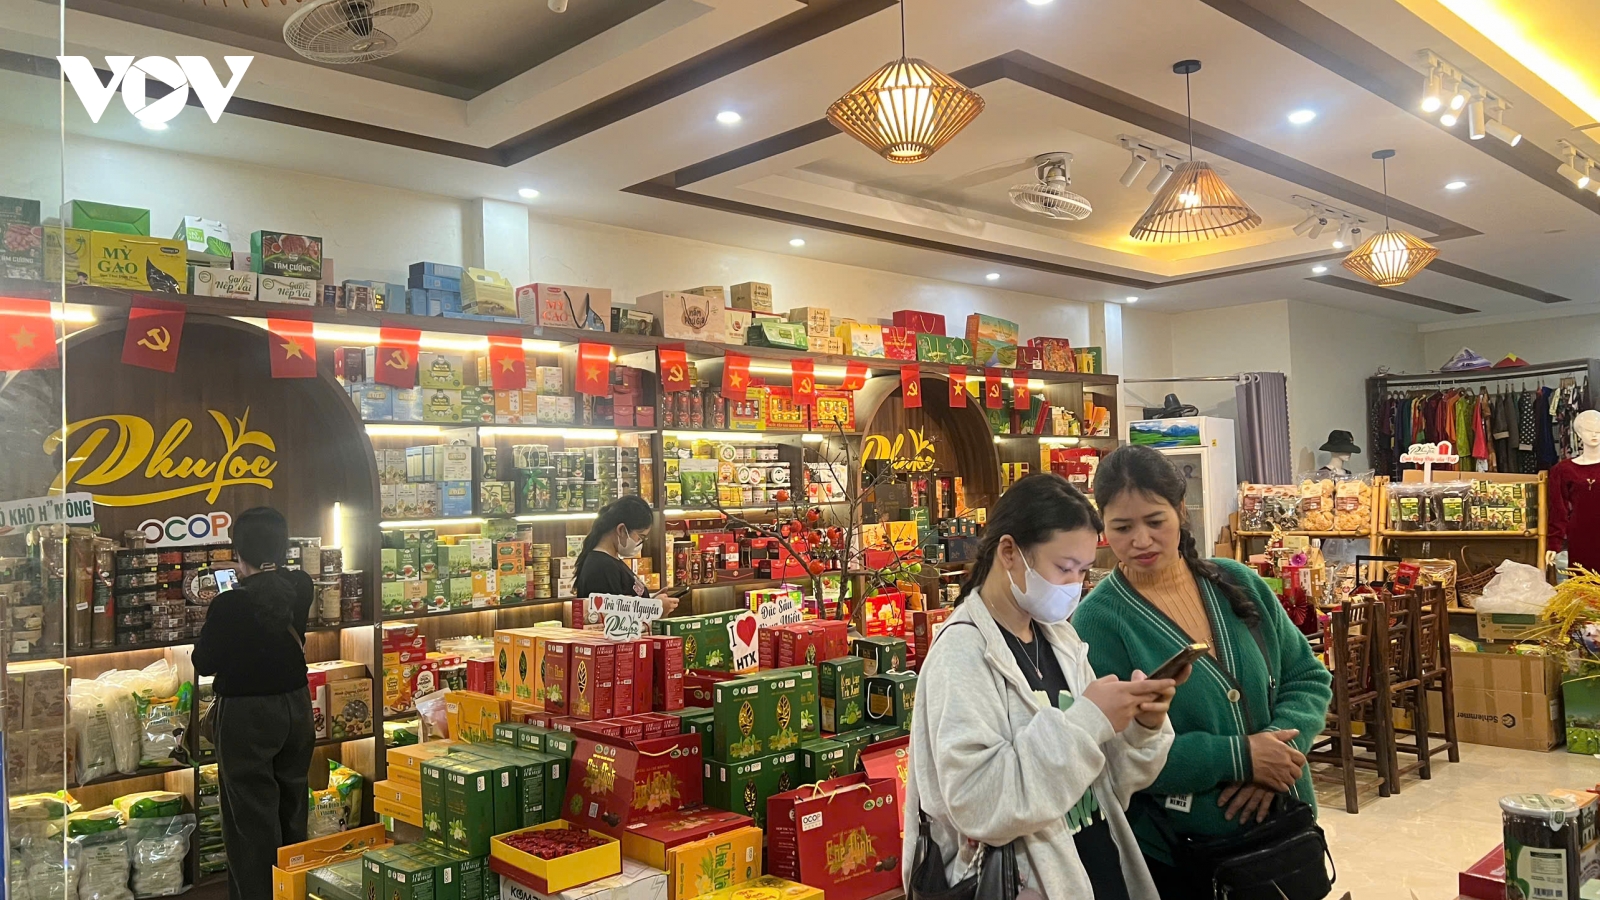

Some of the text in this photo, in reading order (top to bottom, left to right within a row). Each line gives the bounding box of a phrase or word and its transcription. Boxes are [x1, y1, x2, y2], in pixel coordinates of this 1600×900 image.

[9, 504, 35, 526] KHÔ
[141, 514, 229, 544] OCOP
[590, 597, 593, 609] I
[730, 625, 737, 647] I
[736, 651, 757, 670] HTX
[1457, 712, 1499, 724] Schlemmer
[803, 813, 821, 824] OCOP
